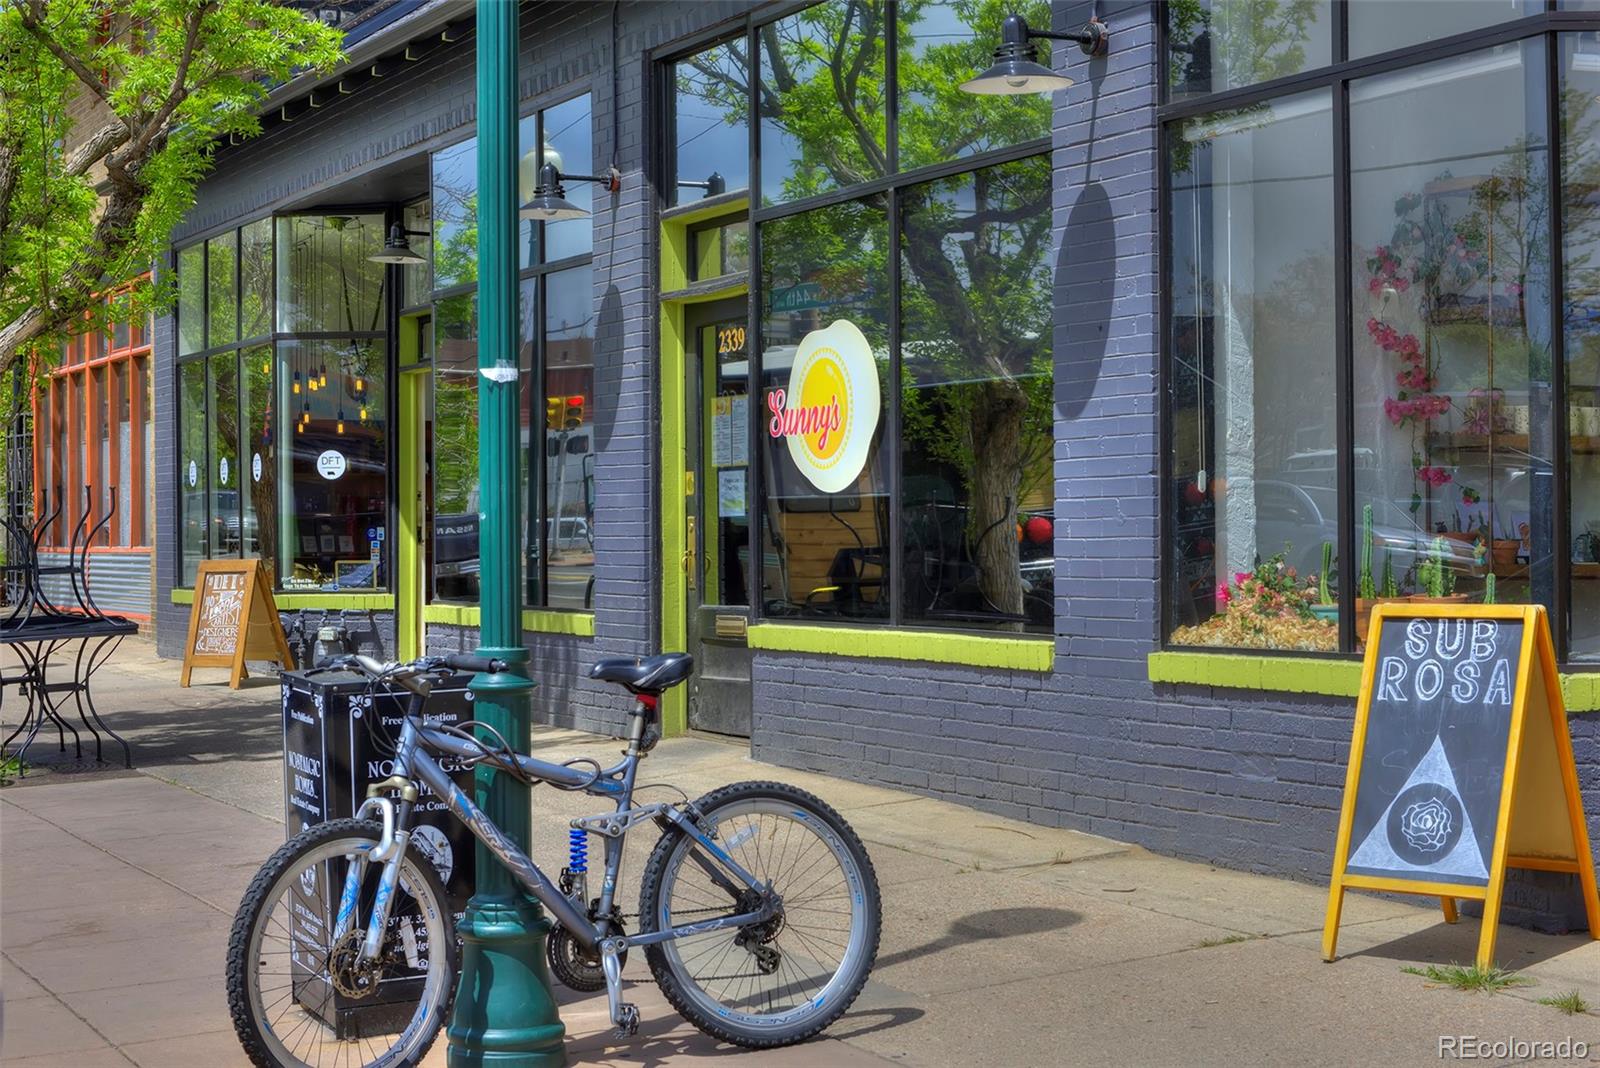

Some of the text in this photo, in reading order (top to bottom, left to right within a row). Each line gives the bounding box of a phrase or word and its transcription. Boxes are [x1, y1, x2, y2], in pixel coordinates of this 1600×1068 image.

[719, 327, 745, 353] 2339
[768, 388, 842, 450] Sunny's
[321, 456, 341, 465] DFT
[1405, 618, 1498, 662] SUB
[1377, 656, 1512, 705] ROSA
[382, 716, 403, 726] Free
